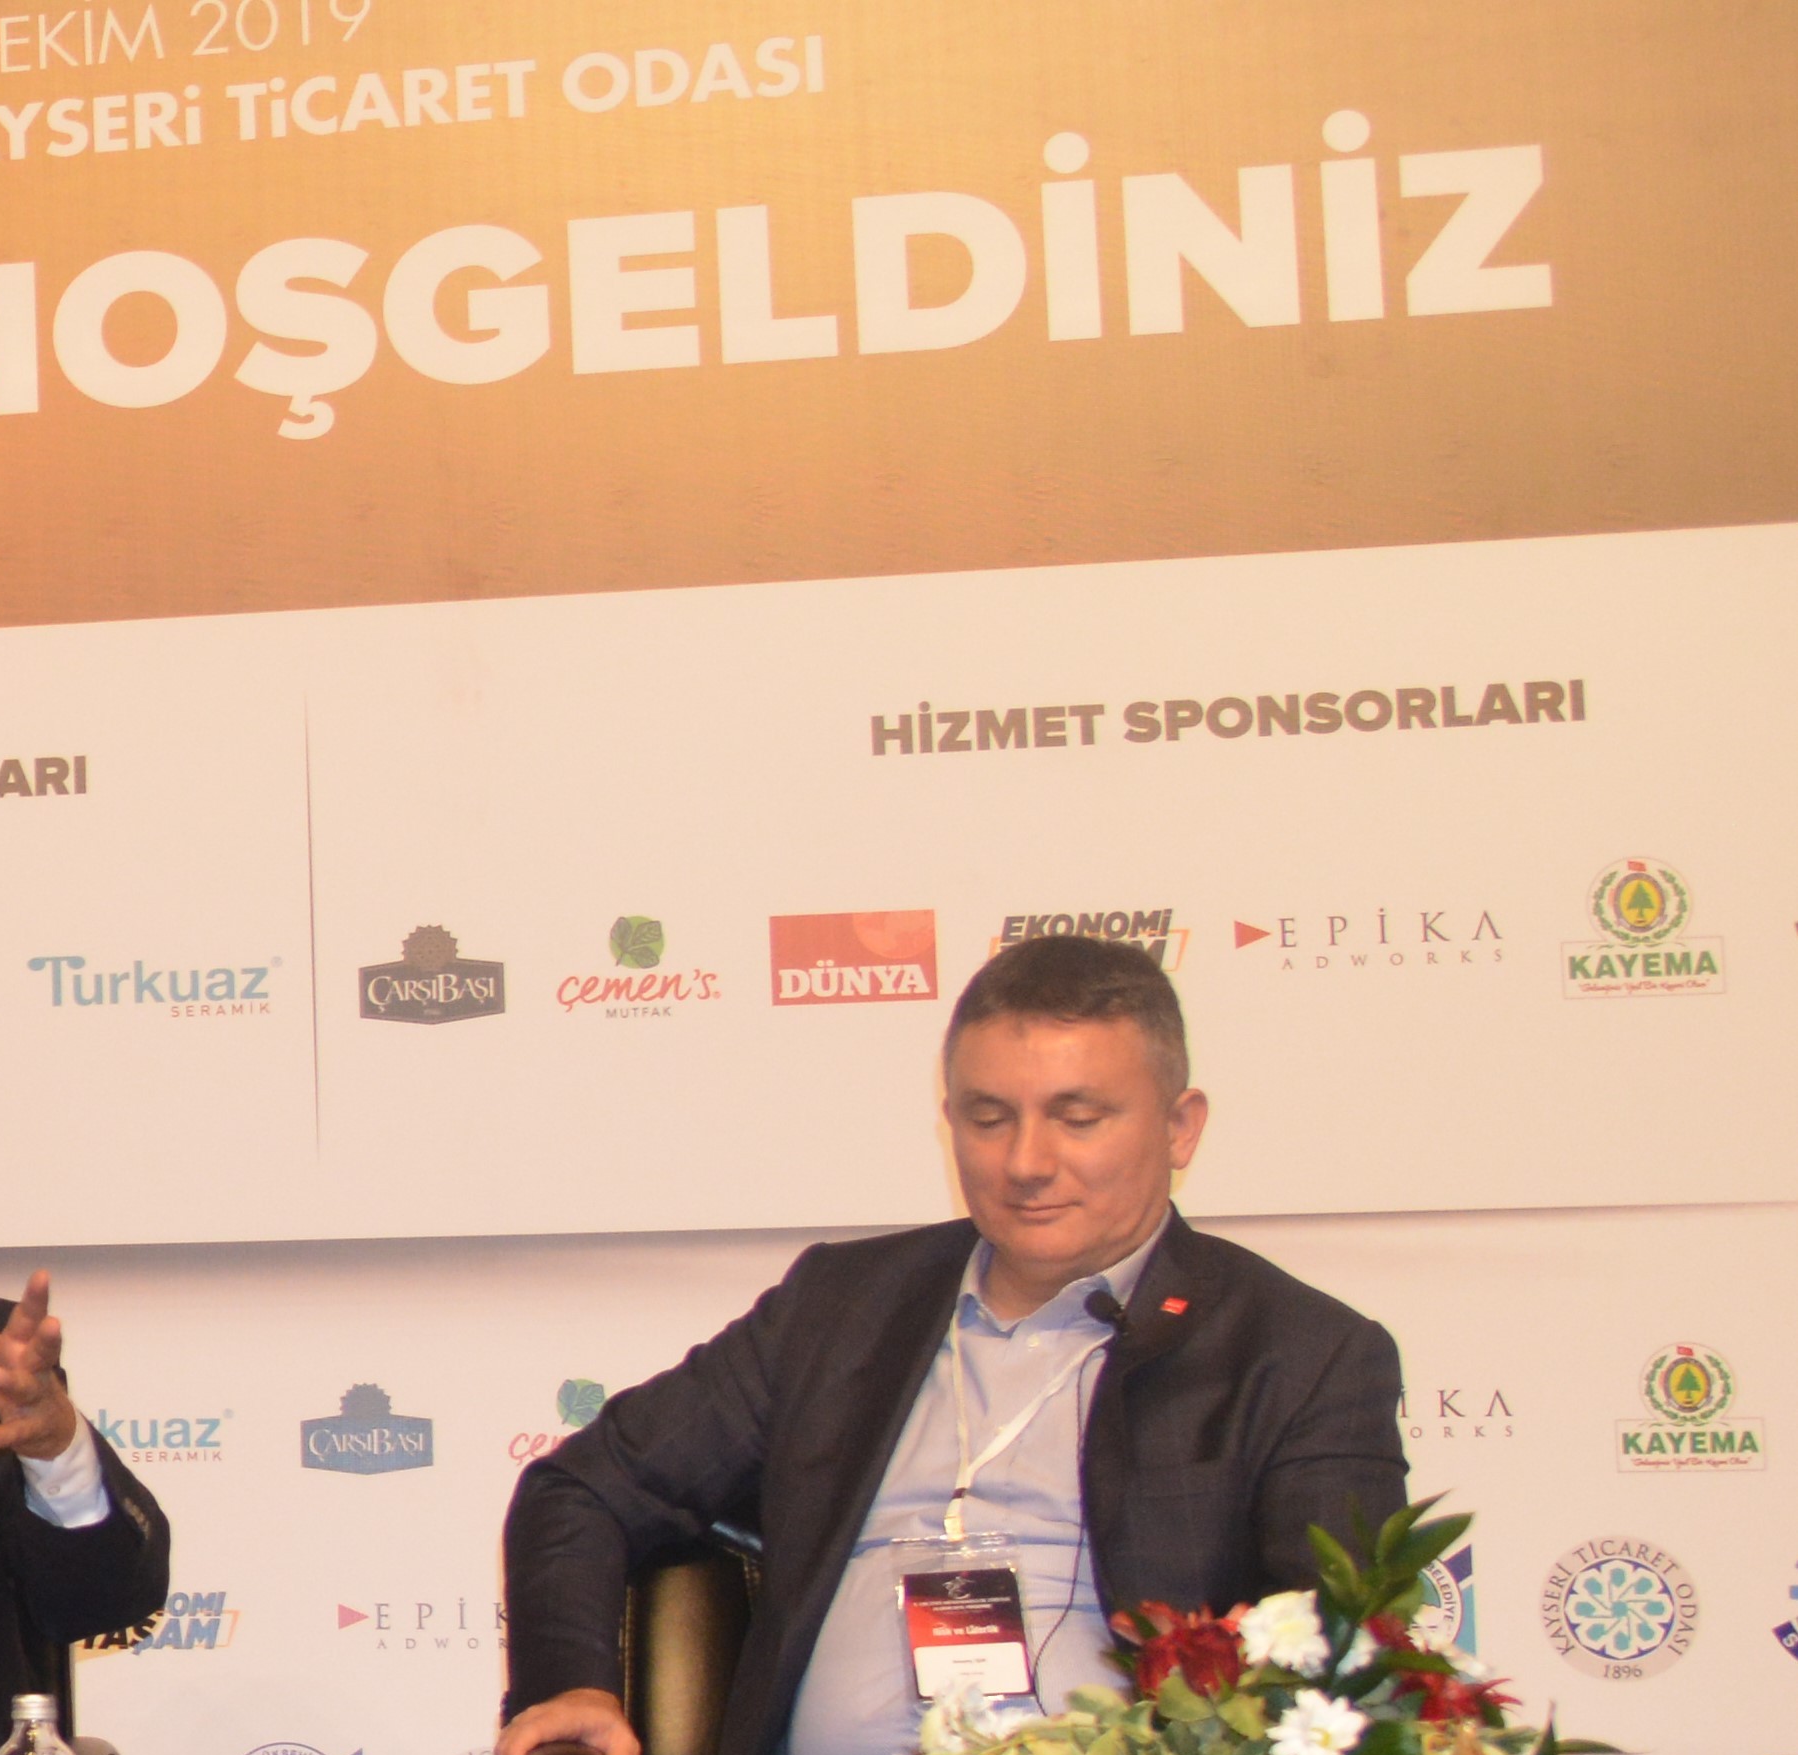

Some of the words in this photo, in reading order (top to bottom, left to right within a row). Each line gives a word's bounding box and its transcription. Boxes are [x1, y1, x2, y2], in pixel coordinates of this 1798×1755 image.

[189, 0, 371, 56] 2019
[562, 35, 824, 113] ODASI
[871, 701, 1104, 756] HİZMET
[1123, 679, 1587, 744] SPONSORLARI
[779, 960, 929, 999] DÜNYA
[1281, 949, 1503, 971] ADWORKS
[1568, 951, 1718, 980] KAYEMA
[27, 956, 269, 1006] Turkuaz
[606, 1006, 672, 1018] MUTFAK
[98, 1408, 221, 1449] kuaz
[1410, 1425, 1512, 1438] ORKS
[1622, 1431, 1759, 1455] KAYEMA
[1668, 1583, 1697, 1656] ODASI
[1604, 1664, 1642, 1679] 1896
